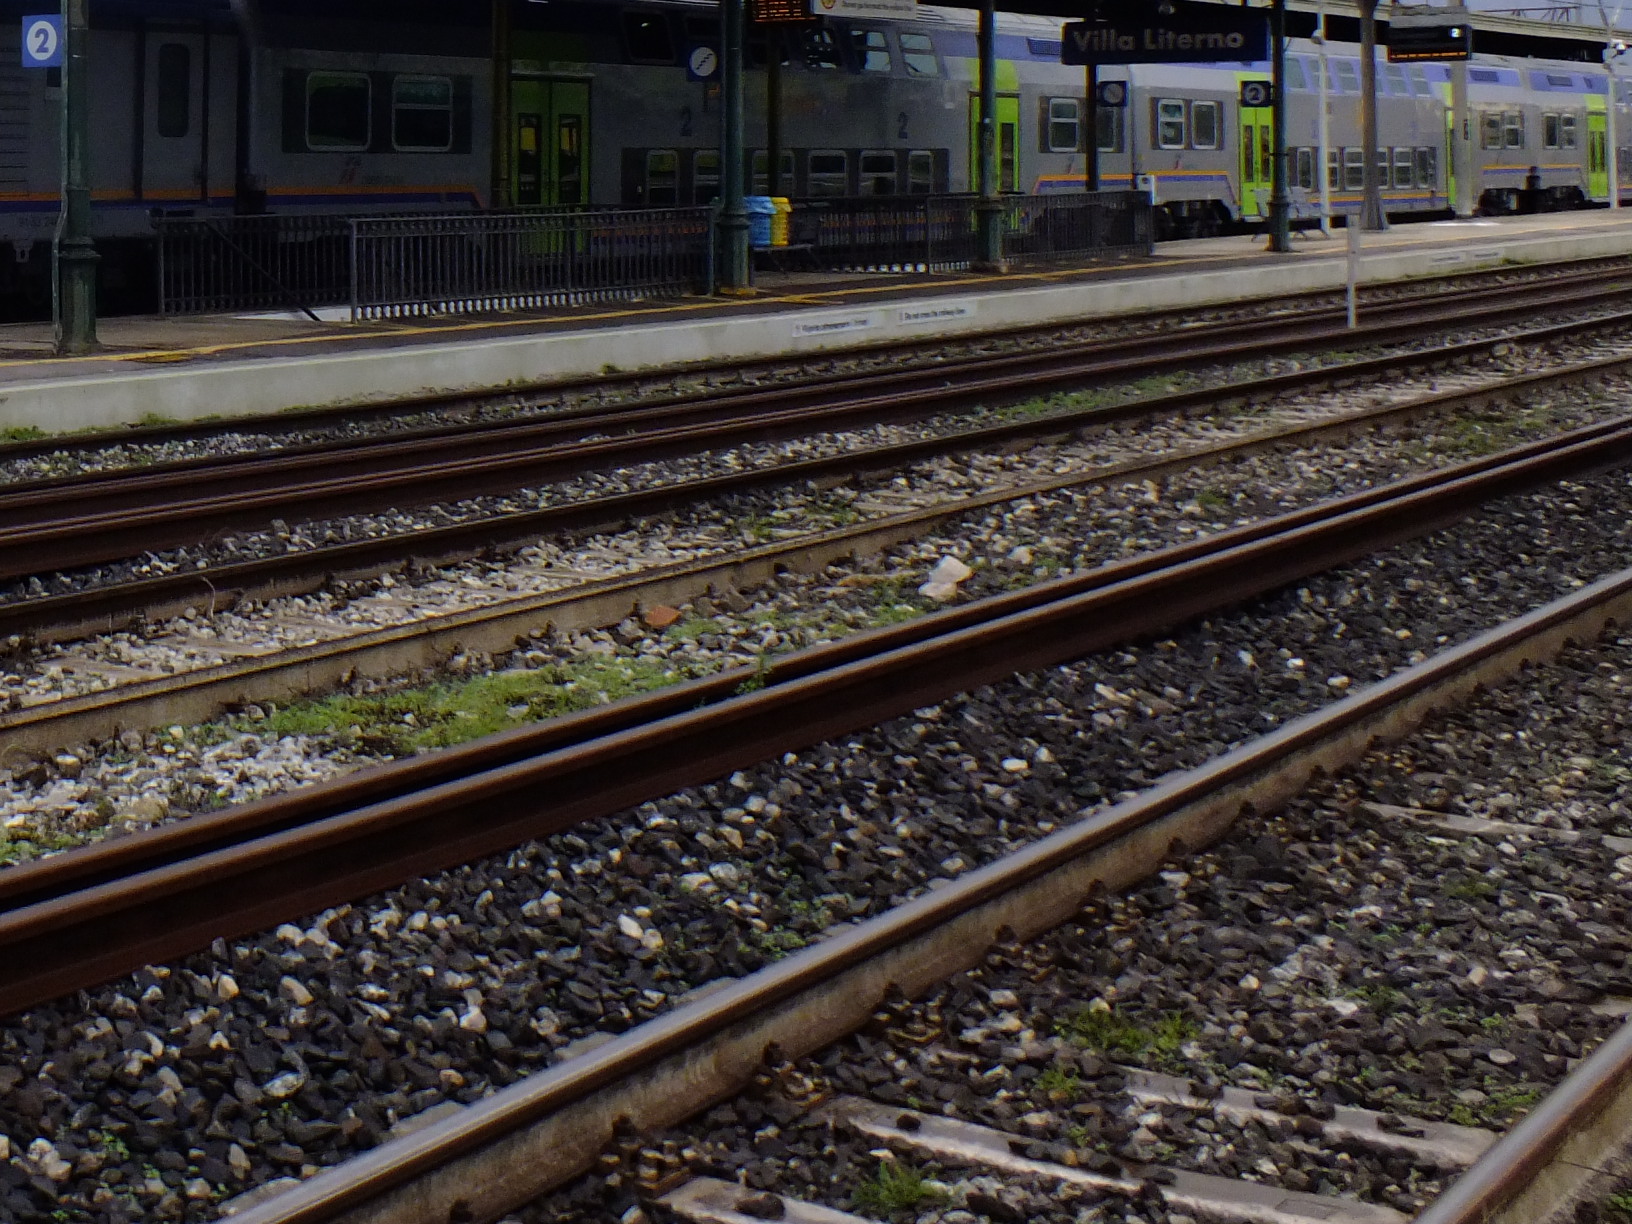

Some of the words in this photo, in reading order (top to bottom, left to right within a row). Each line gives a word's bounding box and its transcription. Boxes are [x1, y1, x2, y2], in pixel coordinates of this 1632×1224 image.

[34, 28, 50, 54] 2
[1073, 29, 1135, 52] Villa
[1144, 28, 1245, 50] Literno
[679, 106, 692, 137] 2
[898, 111, 909, 139] 2
